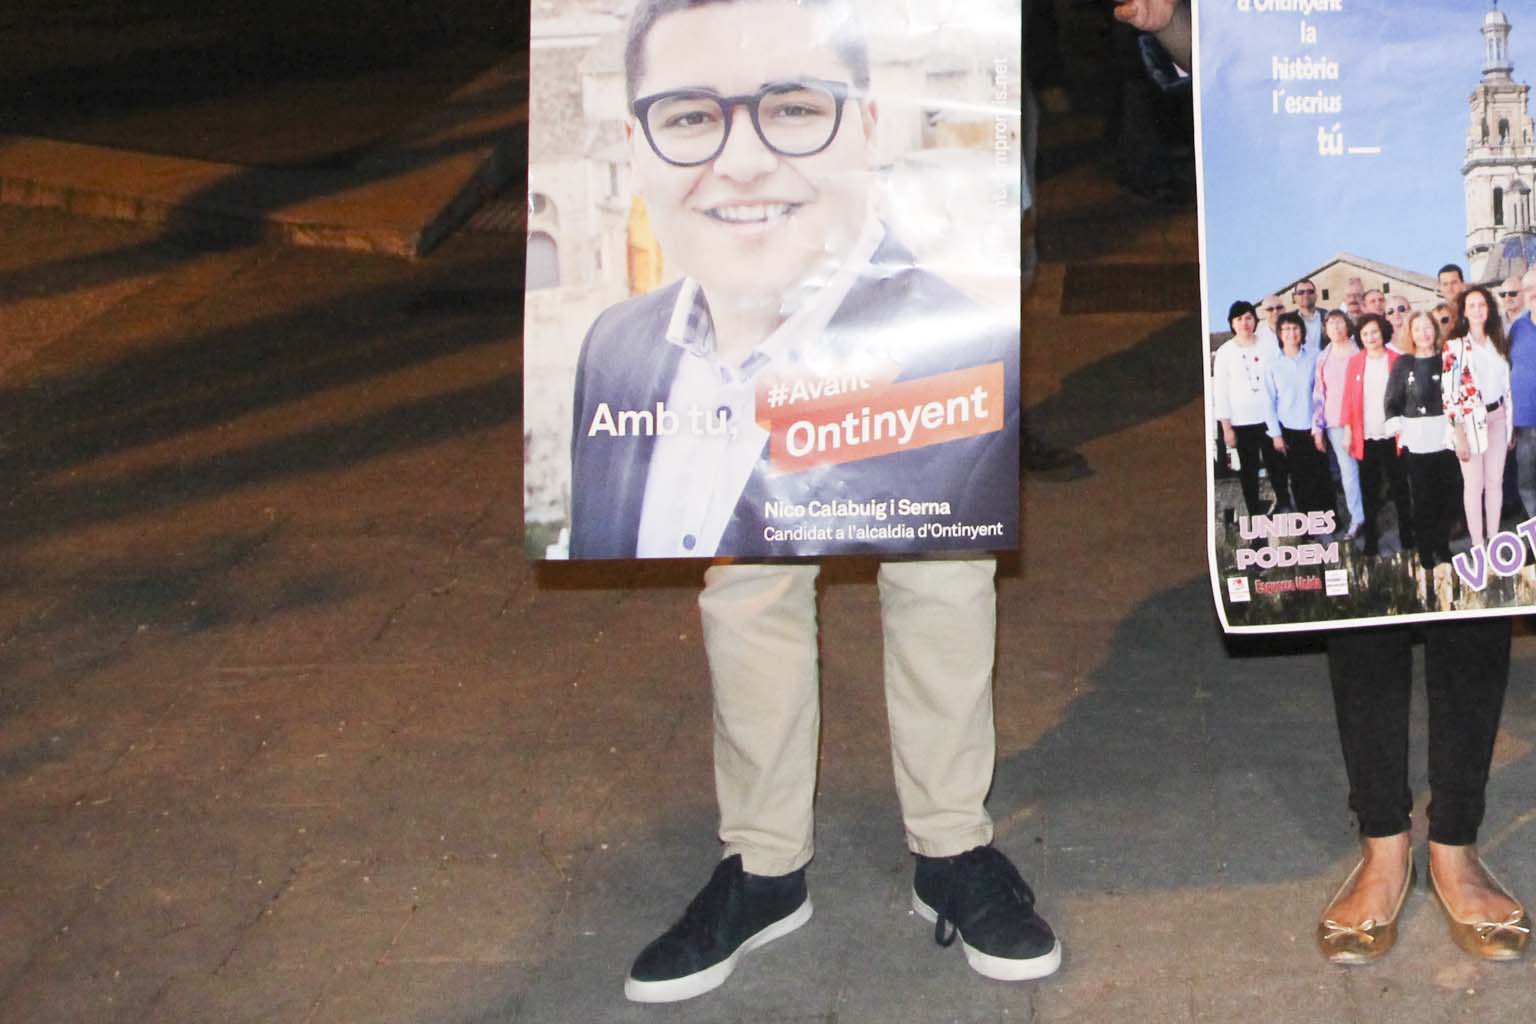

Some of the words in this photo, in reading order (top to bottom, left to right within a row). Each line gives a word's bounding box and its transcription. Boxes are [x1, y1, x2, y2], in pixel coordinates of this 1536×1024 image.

[1300, 20, 1317, 44] la
[1317, 122, 1344, 155] tú
[768, 375, 872, 409] #Avant
[588, 402, 679, 437] Amb
[687, 404, 737, 440] tu,
[785, 386, 989, 458] Ontinyent
[764, 501, 805, 519] Nico
[808, 500, 887, 520] Calabuig
[890, 499, 895, 516] i
[898, 499, 951, 516] Serna
[763, 525, 832, 542] Candidat
[835, 529, 845, 541] a
[848, 524, 915, 540] l'alcaldia
[917, 521, 1004, 540] d'Ontinyent
[1239, 510, 1337, 540] UNIDES
[1236, 542, 1339, 570] PODEM
